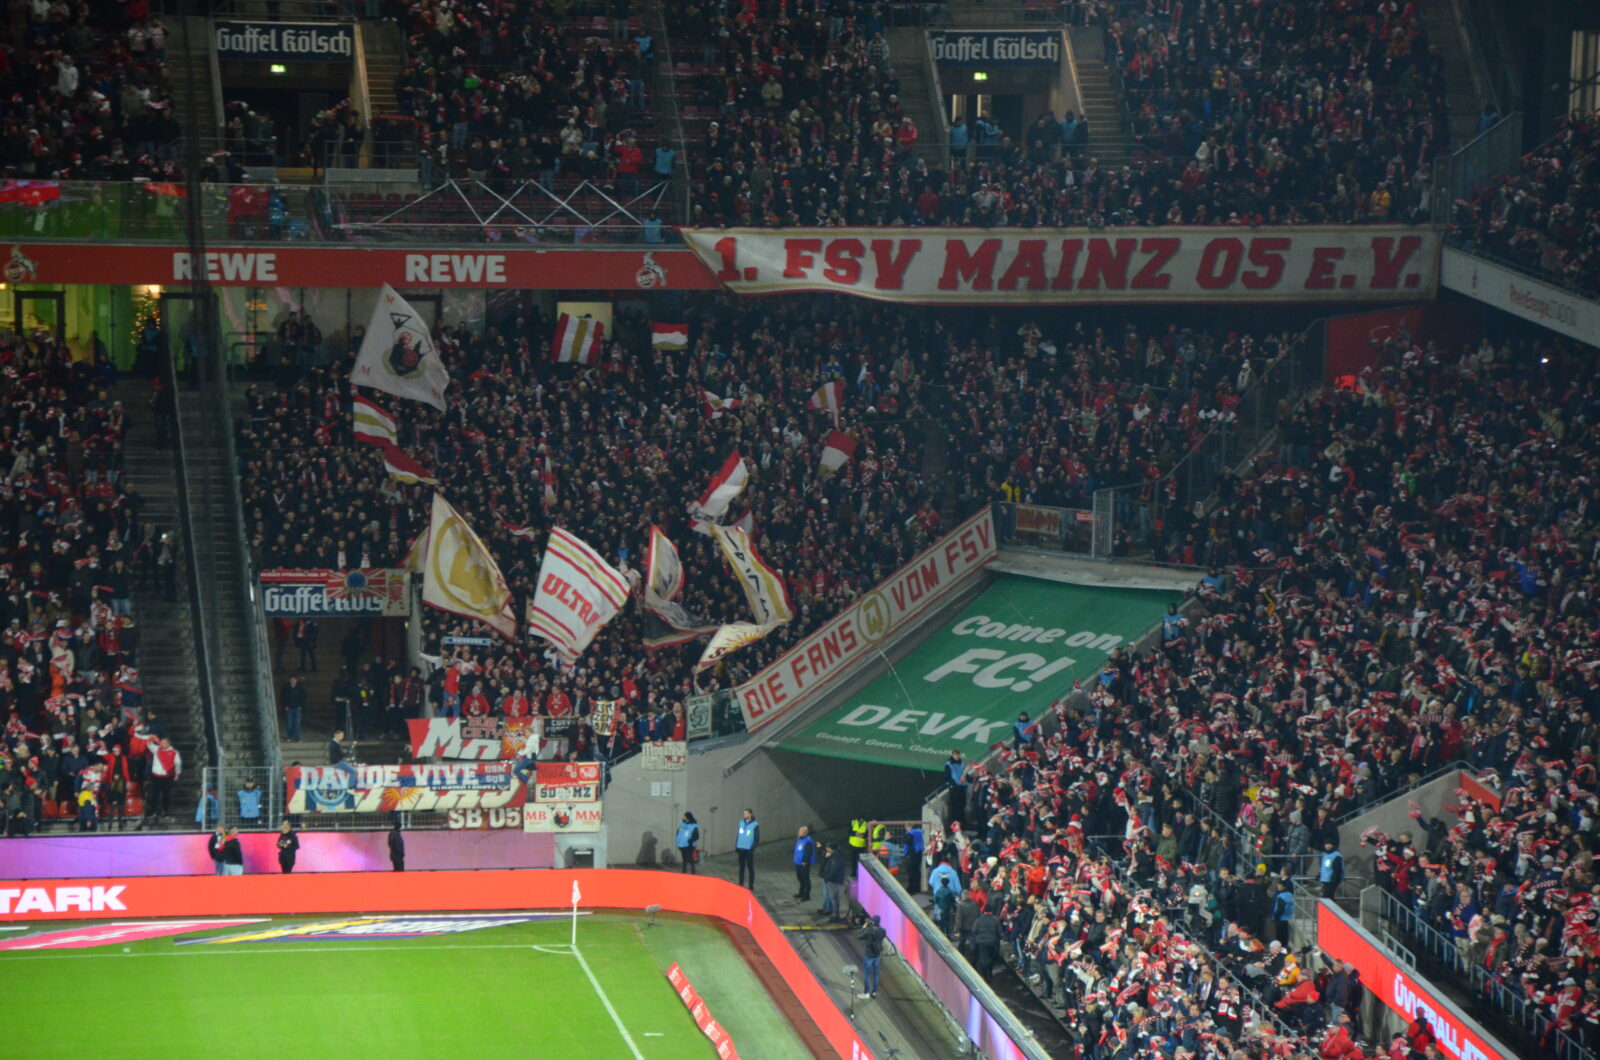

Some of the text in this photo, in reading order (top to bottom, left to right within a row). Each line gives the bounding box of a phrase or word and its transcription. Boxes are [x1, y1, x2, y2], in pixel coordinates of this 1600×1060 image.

[215, 25, 352, 56] Gaffel Kölsch
[931, 35, 1059, 62] Gaffel Kölsch
[173, 252, 278, 281] REWE
[406, 254, 507, 283] REWE
[714, 237, 758, 281] 1.
[783, 238, 922, 290] FSV
[938, 238, 1181, 290] MAINZ
[1196, 237, 1292, 289] 05
[264, 587, 329, 613] Gaffel
[743, 672, 787, 719] DIE
[790, 619, 857, 688] FANS
[891, 557, 940, 612] VOM
[944, 518, 991, 575] FSV
[951, 614, 1066, 644] Come
[923, 648, 1077, 692] FC!
[836, 704, 1010, 744] DEVK
[908, 744, 967, 760] Geholfn.
[411, 764, 480, 787] VIVE
[448, 809, 482, 829] SB
[525, 810, 601, 821] MB MM
